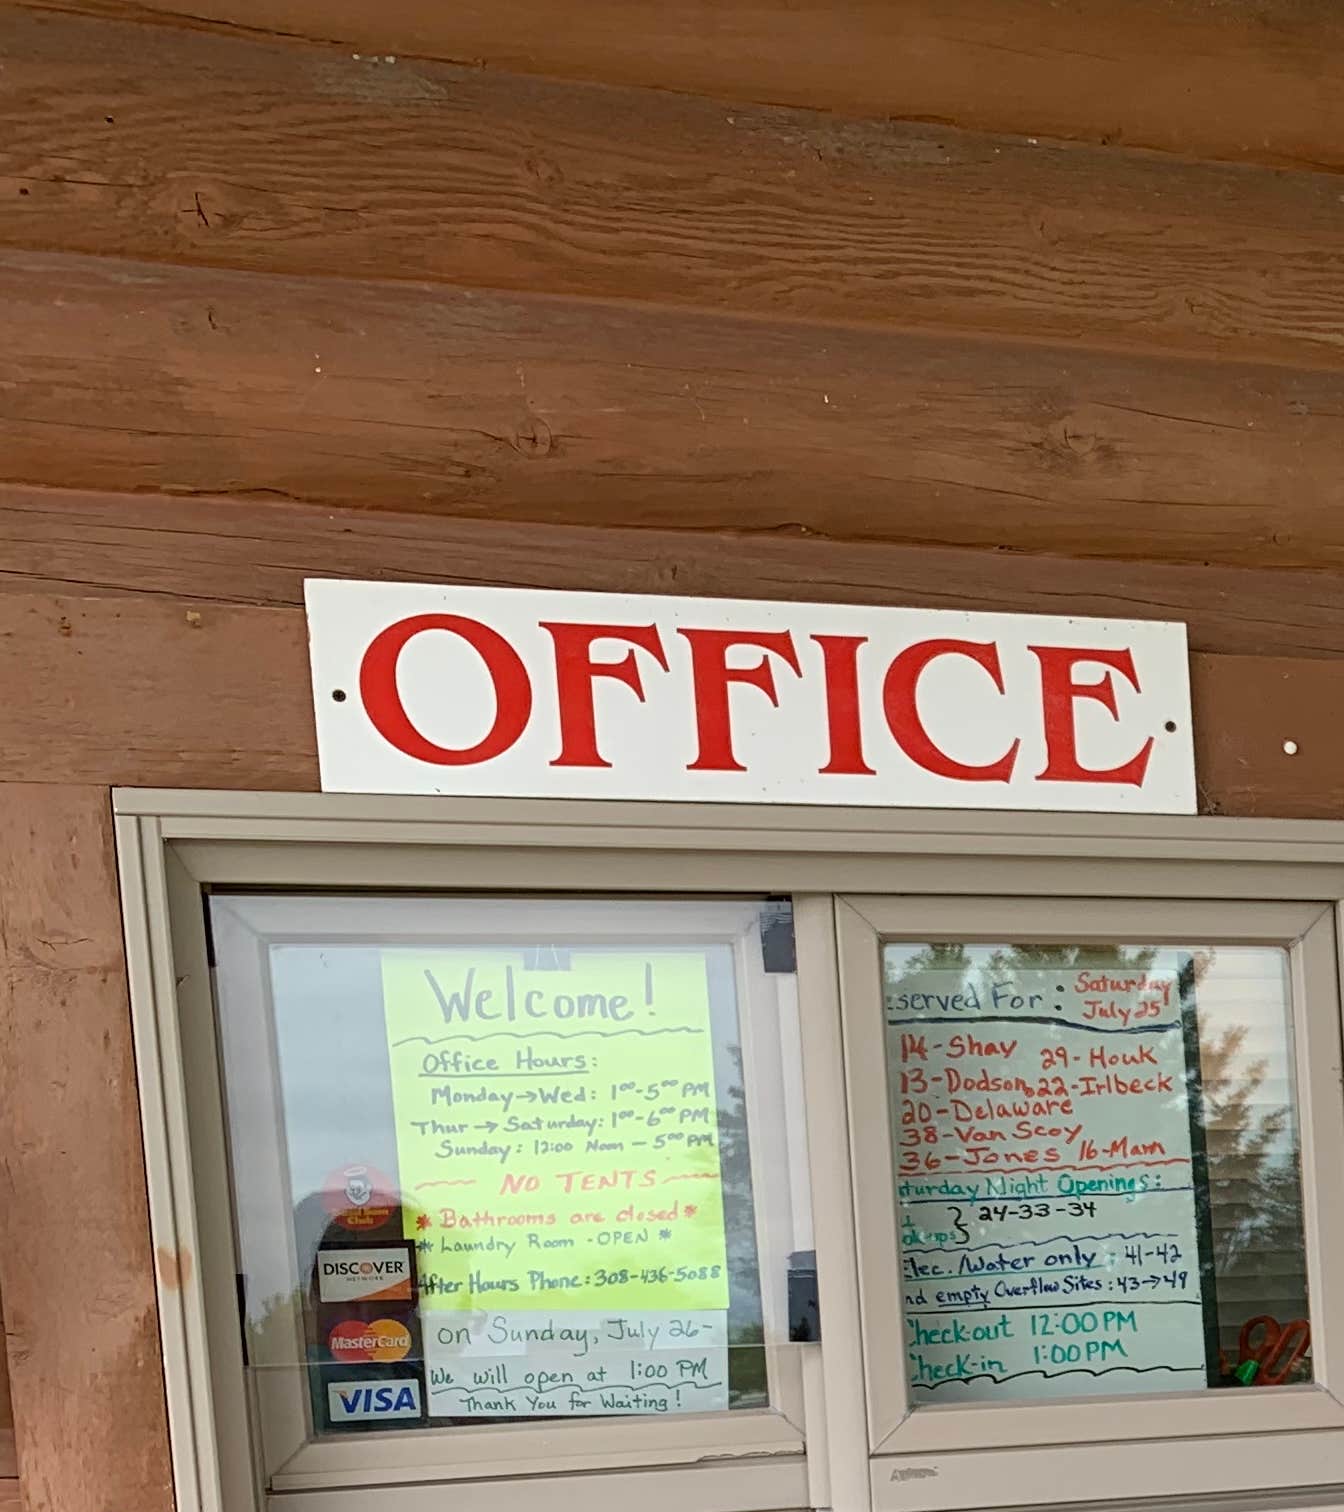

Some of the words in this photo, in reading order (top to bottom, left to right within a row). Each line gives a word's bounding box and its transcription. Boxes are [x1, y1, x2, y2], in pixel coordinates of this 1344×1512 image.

[359, 613, 1154, 788] OFFICE
[424, 962, 656, 1024] Welcome!
[1075, 973, 1173, 1005] Saturday
[1083, 1000, 1131, 1026] July
[1134, 1000, 1160, 1017] 25
[422, 1050, 498, 1074] Office
[516, 1046, 598, 1070] Hours:
[500, 1173, 539, 1195] NO
[556, 1170, 657, 1193] TENTS
[440, 1208, 556, 1228] Bathrooms
[570, 1212, 605, 1224] are
[616, 1200, 678, 1222] closed
[323, 1261, 403, 1276] DISCOVER
[417, 1273, 462, 1295] After
[469, 1273, 519, 1294] Hours
[331, 1333, 408, 1350] MasterCard
[430, 1365, 453, 1385] We
[473, 1365, 508, 1385] will
[525, 1369, 573, 1393] open
[587, 1366, 607, 1382] at
[631, 1361, 668, 1380] 1:00
[676, 1359, 708, 1380] PM
[336, 1387, 416, 1414] VISA
